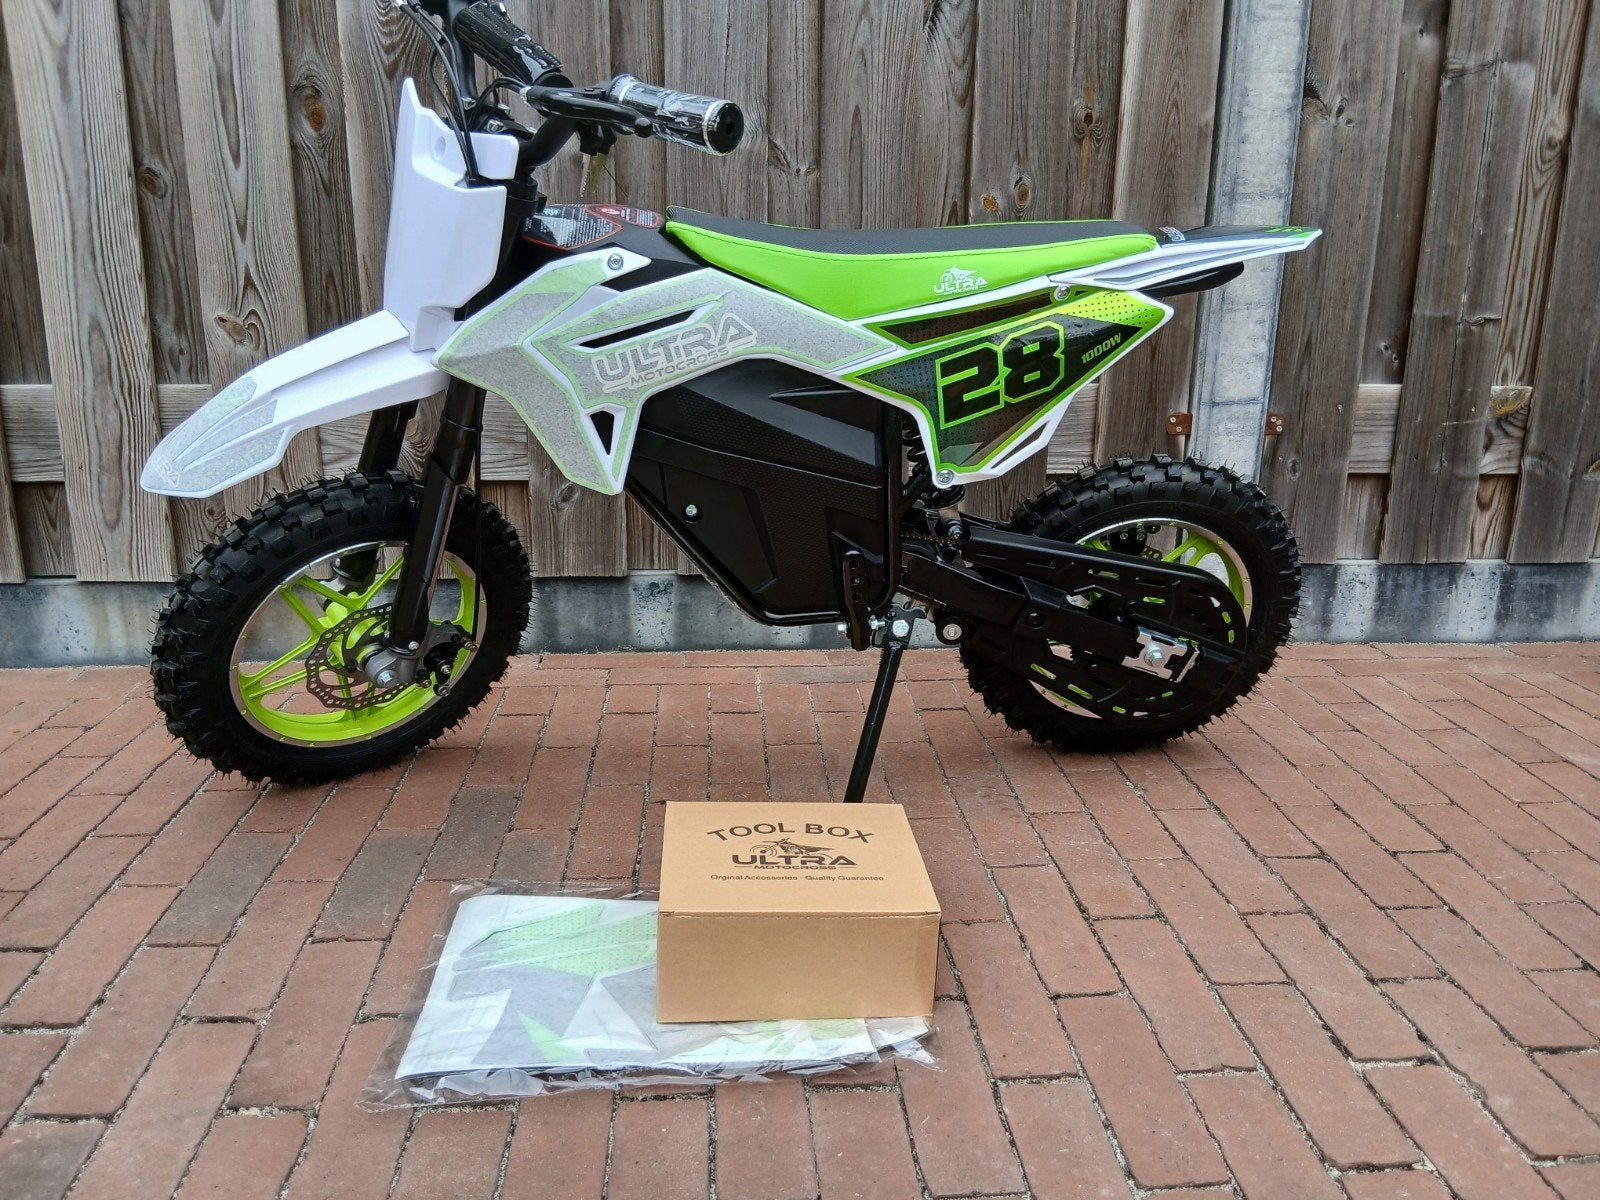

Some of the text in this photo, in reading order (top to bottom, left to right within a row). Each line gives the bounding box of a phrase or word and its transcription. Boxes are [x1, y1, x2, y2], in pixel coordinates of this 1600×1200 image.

[933, 276, 988, 293] ULTRA
[594, 312, 757, 383] ULTRA
[1081, 332, 1122, 364] 1000W
[630, 345, 729, 387] MOTOCROSS
[935, 320, 1065, 430] 28
[707, 822, 874, 844] TOOL BOX
[732, 854, 858, 866] ULTRA
